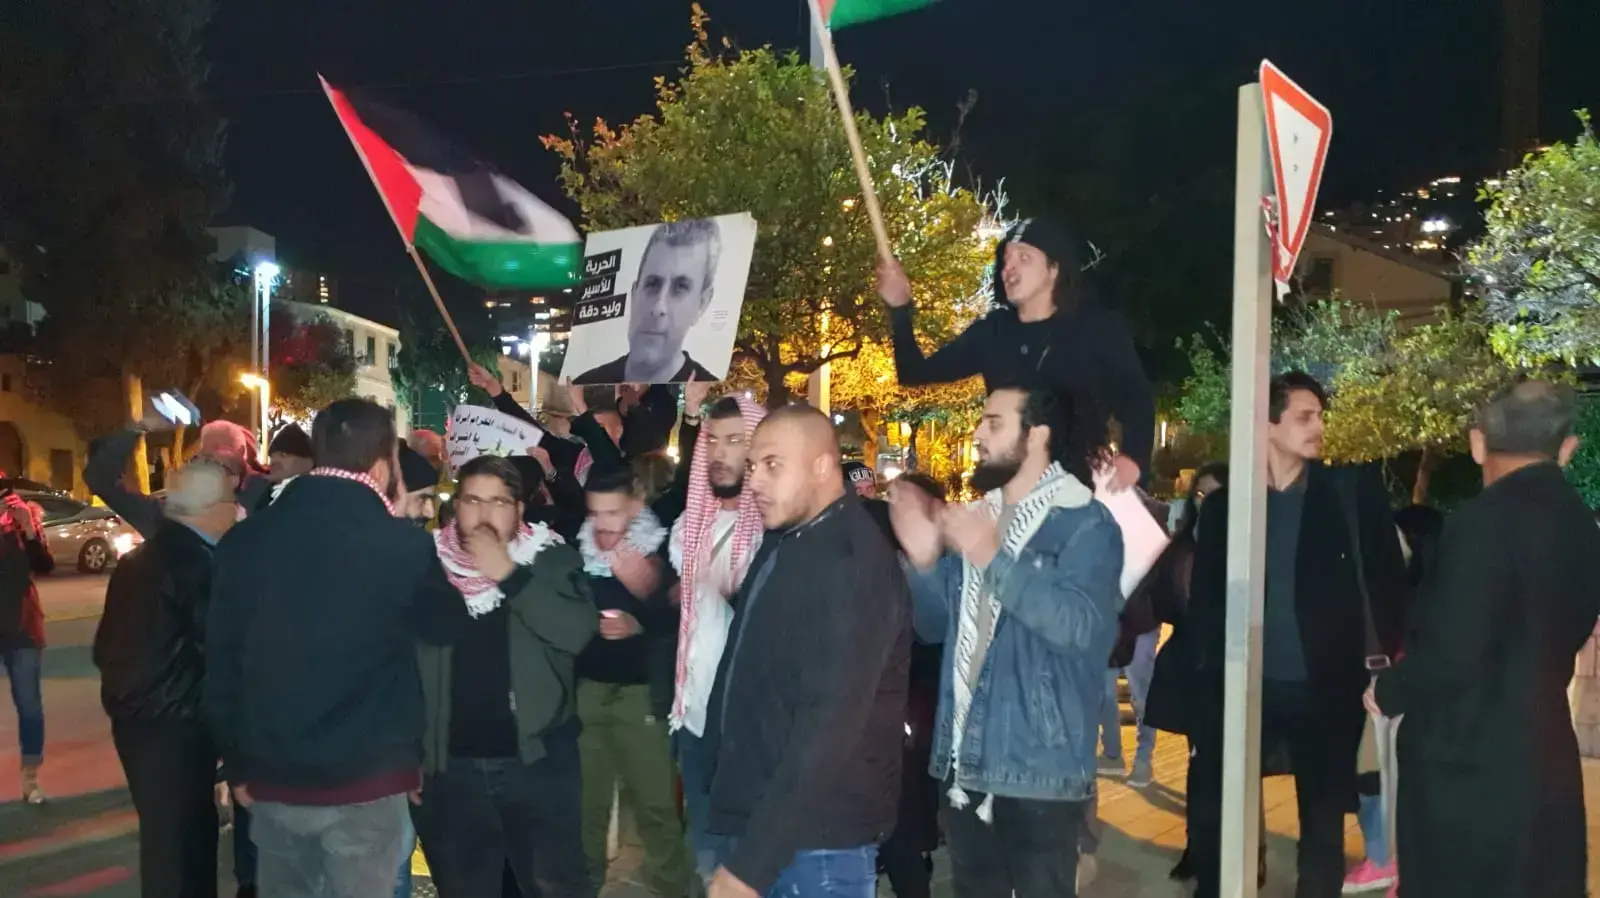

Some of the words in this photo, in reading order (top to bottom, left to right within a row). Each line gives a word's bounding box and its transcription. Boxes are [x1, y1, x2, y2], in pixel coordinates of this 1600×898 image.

[586, 255, 616, 275] الحرية
[581, 276, 612, 300] للأسير
[579, 304, 599, 319] دقة
[601, 301, 622, 317] وليد
